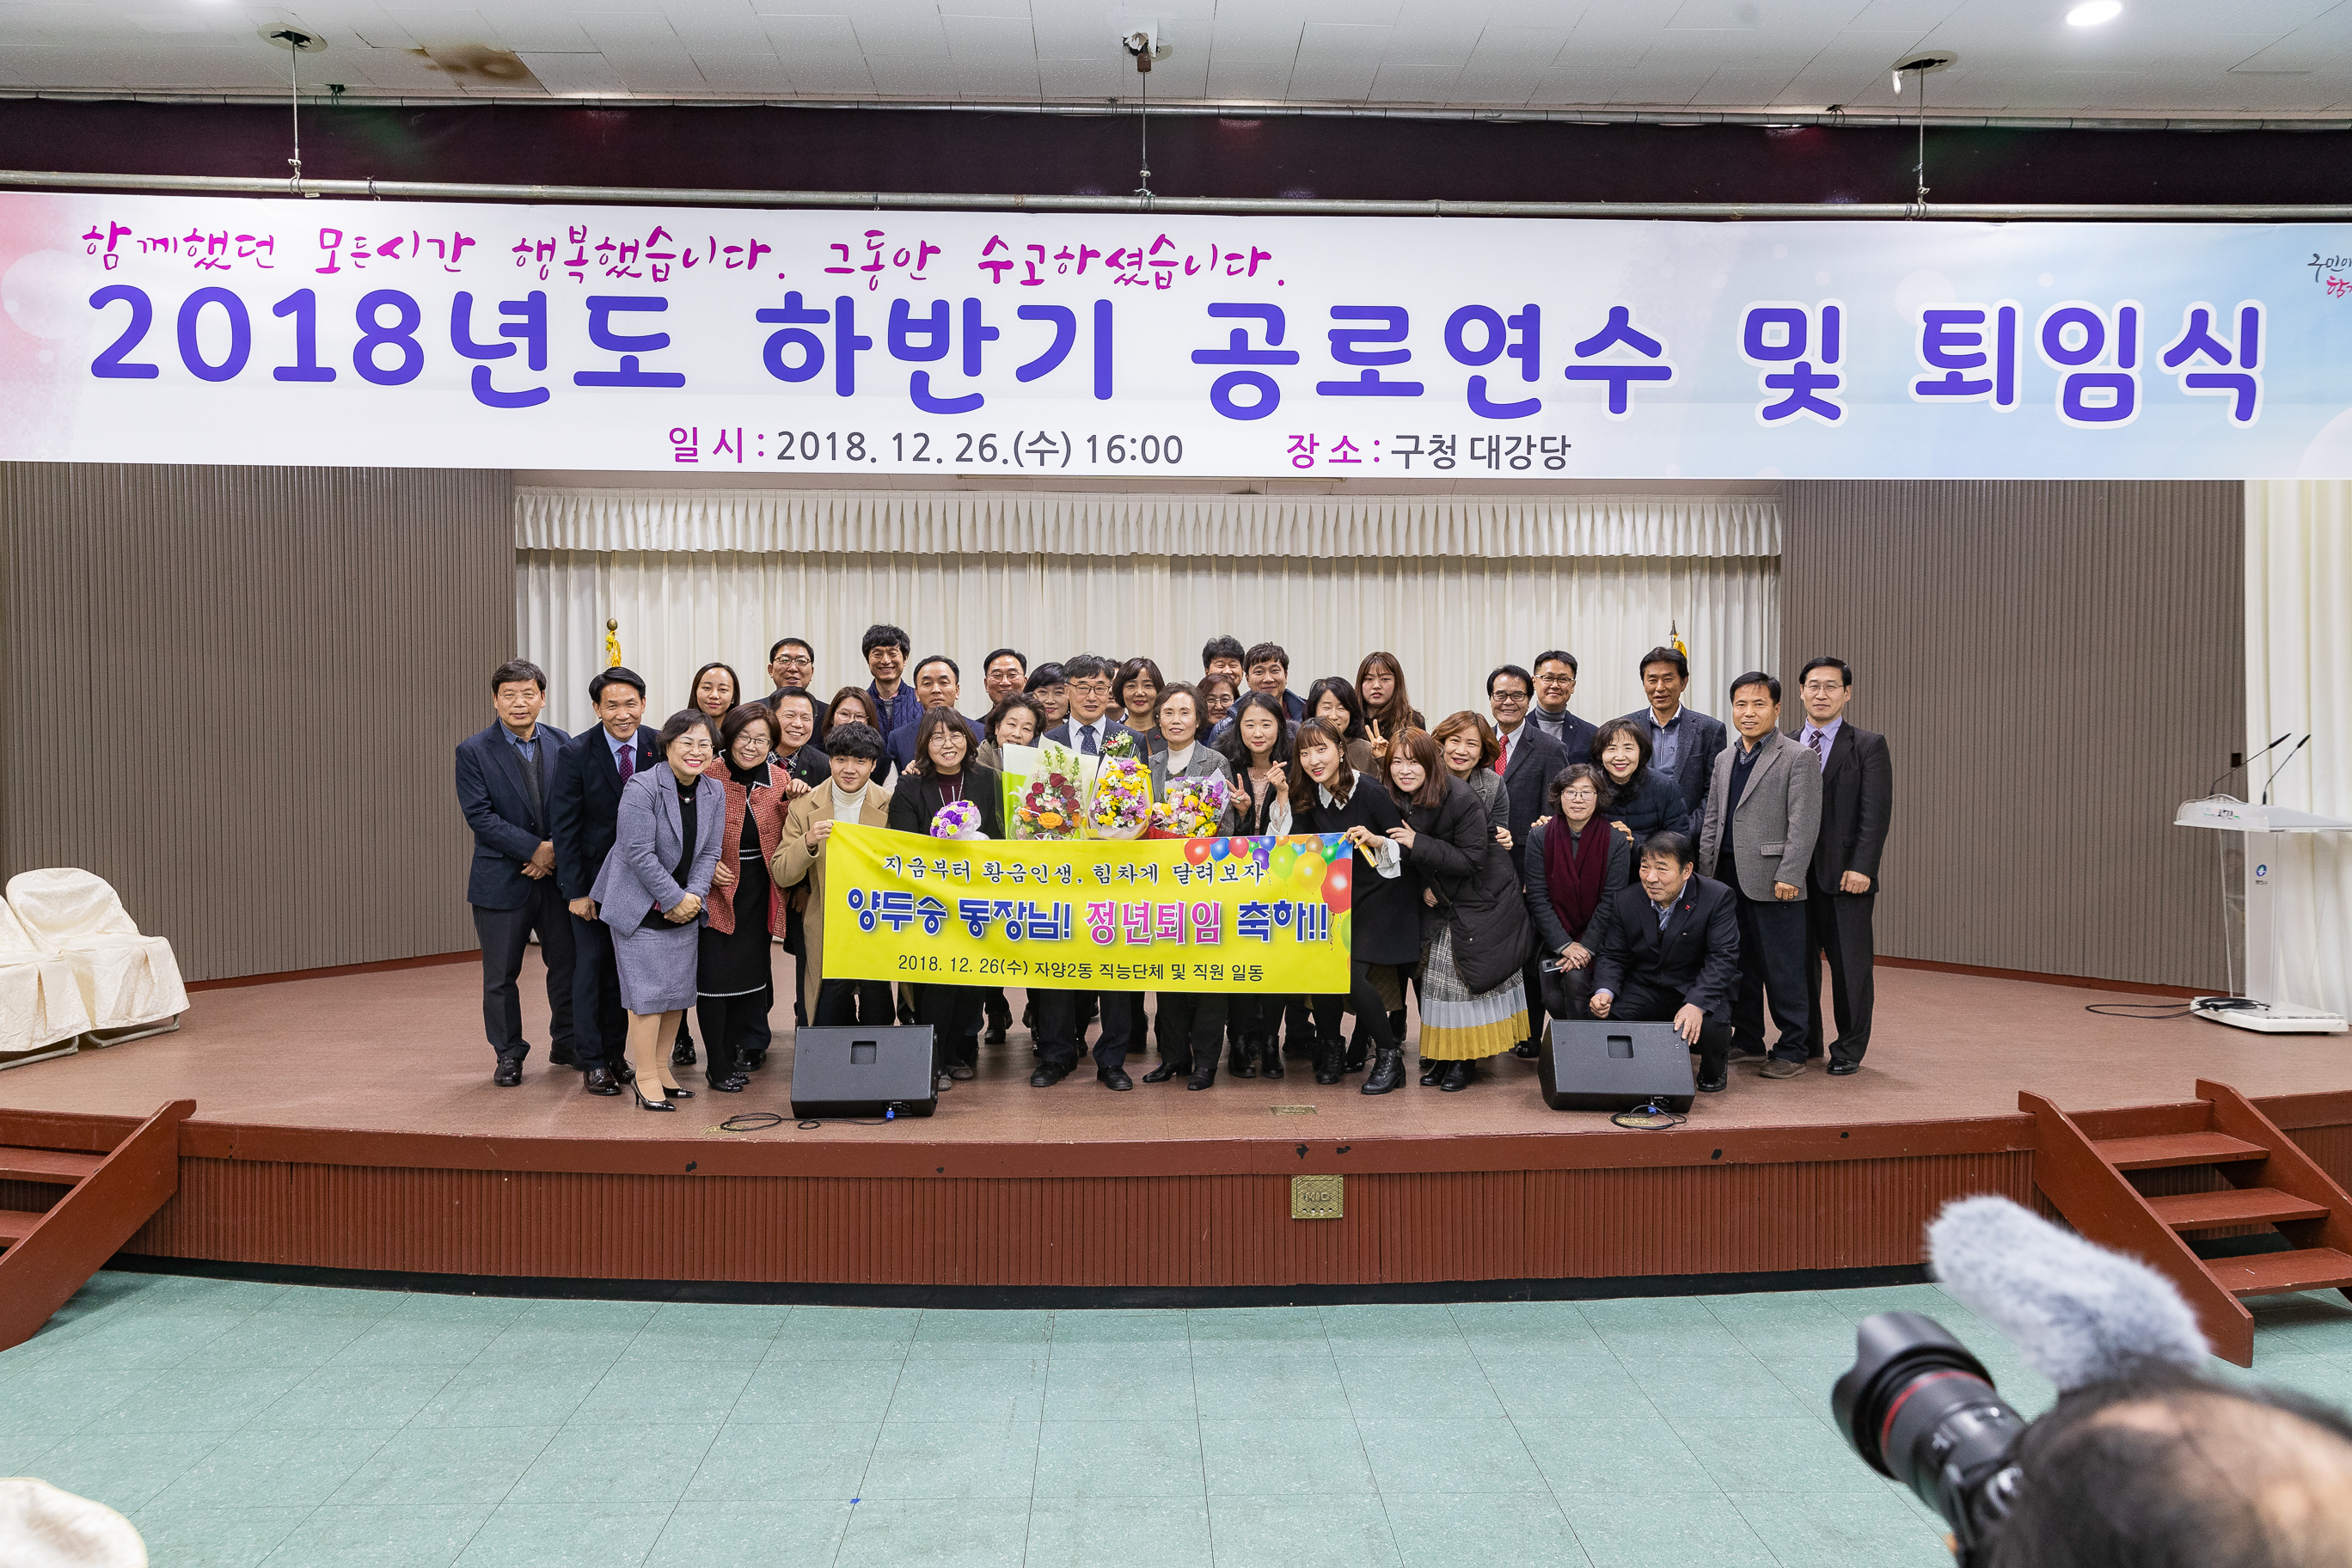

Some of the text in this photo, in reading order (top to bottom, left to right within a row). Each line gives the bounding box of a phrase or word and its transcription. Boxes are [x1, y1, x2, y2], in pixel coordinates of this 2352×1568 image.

[83, 220, 274, 271] 함께했던
[512, 224, 785, 284] 행복했습니다.
[824, 230, 941, 291] 그동안
[977, 233, 1284, 291] 수고하셨습니다.
[89, 284, 2259, 422] 2018년도 하반기 공로연수 및 퇴임식
[777, 431, 877, 463] 2018.
[892, 432, 943, 464] 12.
[955, 431, 1071, 469] 26.(수)
[1087, 434, 1183, 464] 16:00
[1391, 434, 1456, 470] 구청
[1470, 434, 1571, 470] 대강당
[885, 855, 1264, 886] 지금부터 황금인생, 힘차게 달려보자
[959, 898, 1071, 940] 동장님!
[1085, 899, 1222, 945] 정년퇴임
[1237, 899, 1328, 943] 축하!!
[898, 954, 1264, 982] 2018. 12. 26(수) 자양2동 직능단체 및 직원 일동
